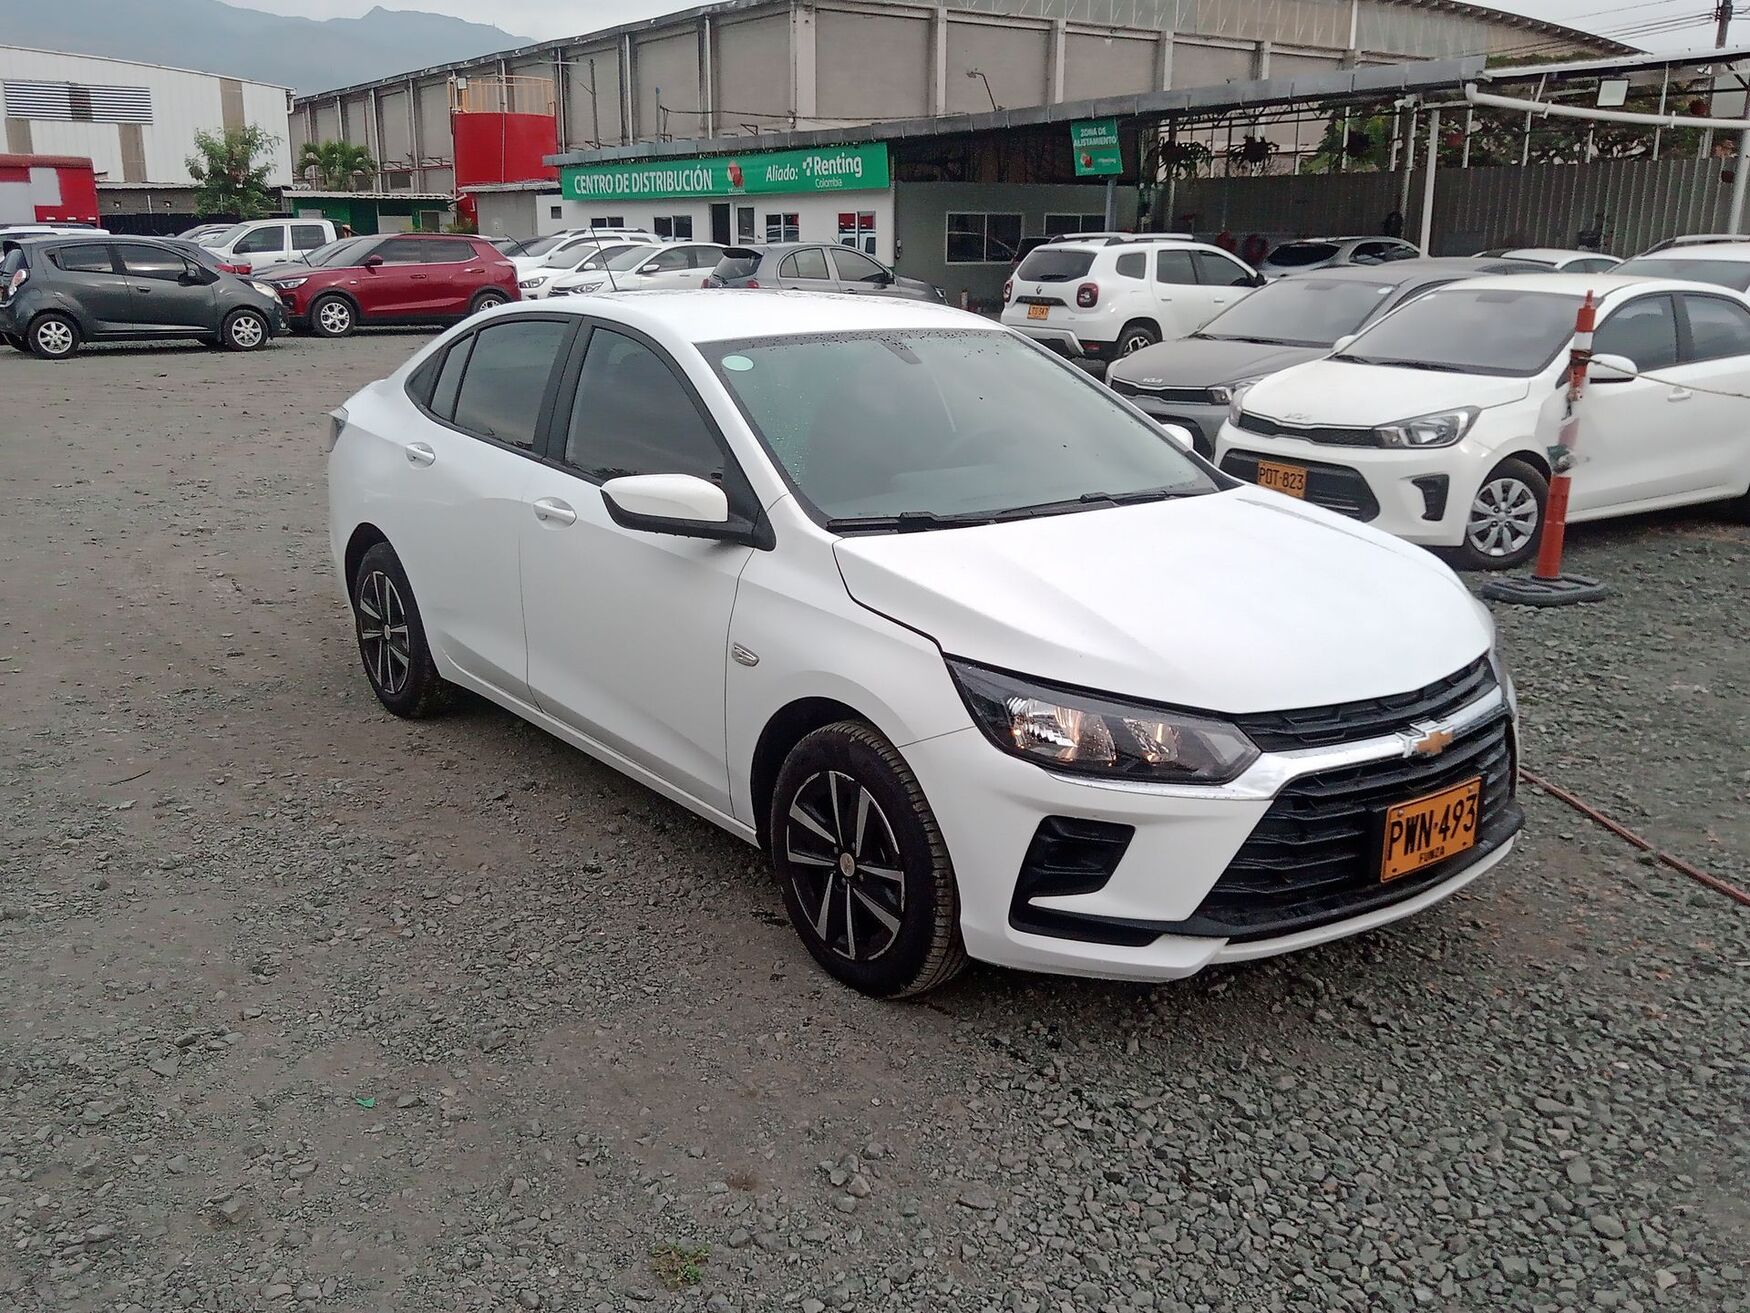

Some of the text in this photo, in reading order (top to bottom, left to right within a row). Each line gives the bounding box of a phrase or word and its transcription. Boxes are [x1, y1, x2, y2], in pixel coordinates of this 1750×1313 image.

[1098, 126, 1106, 135] DE
[766, 164, 798, 182] Aliado:
[814, 152, 862, 177] Renting
[574, 165, 712, 194] CENTRO DE DISTRIBUCIÓN
[815, 178, 842, 188] Colombia
